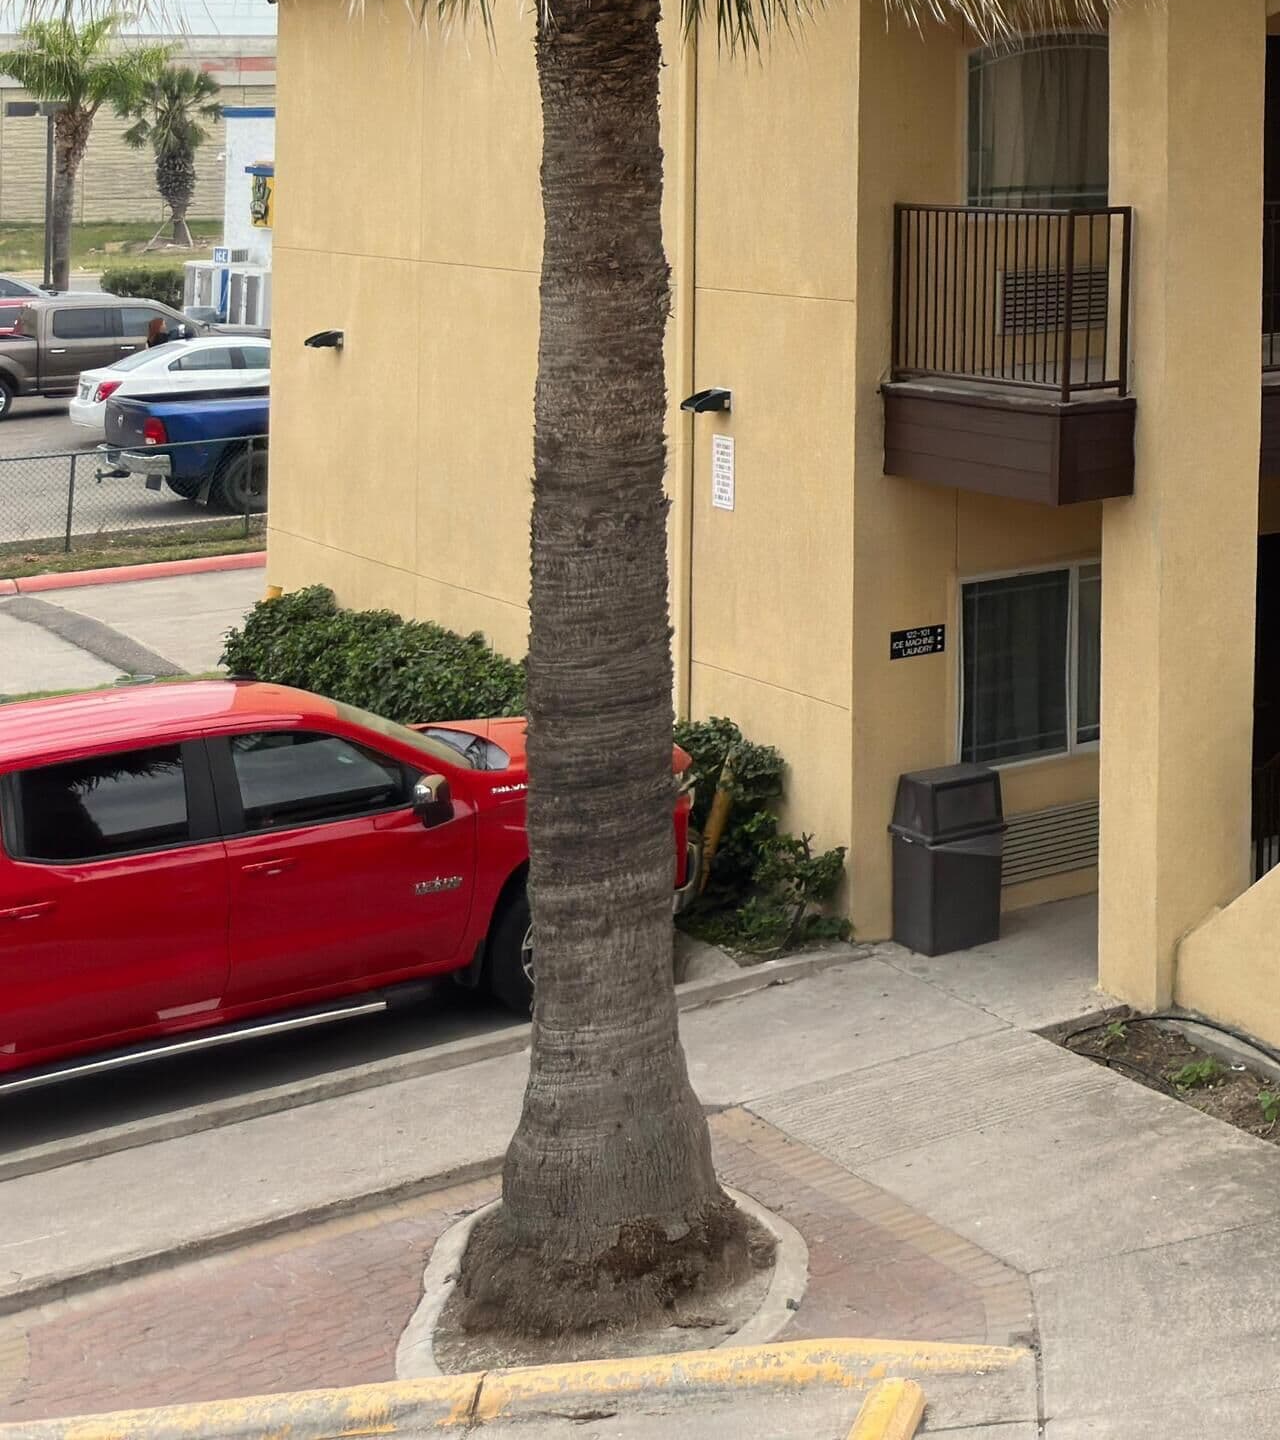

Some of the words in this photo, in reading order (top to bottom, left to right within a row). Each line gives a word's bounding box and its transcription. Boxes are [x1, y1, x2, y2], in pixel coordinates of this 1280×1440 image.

[892, 640, 904, 649] ICE
[904, 635, 935, 648] MACHINE
[902, 644, 934, 657] LAUNDRY
